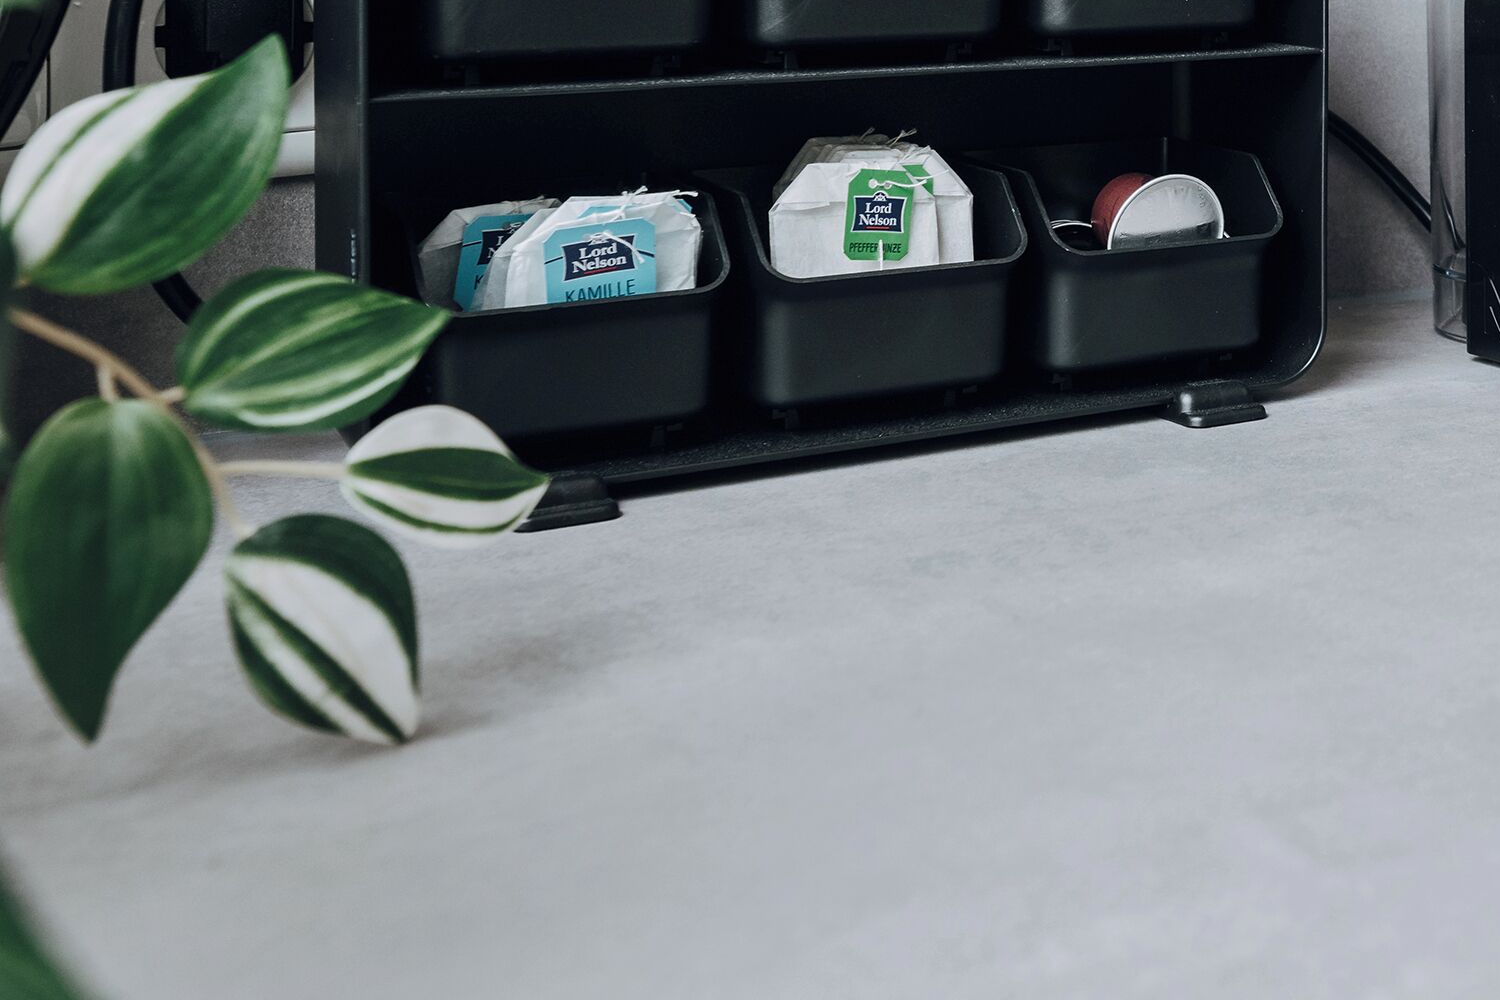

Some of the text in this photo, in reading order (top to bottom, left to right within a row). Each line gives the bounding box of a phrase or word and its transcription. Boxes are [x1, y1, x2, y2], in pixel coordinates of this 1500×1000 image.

[865, 202, 892, 214] Lord
[858, 213, 897, 226] Nelson
[578, 242, 618, 260] Lord
[849, 242, 902, 253] PFEFFERINZE
[571, 256, 627, 274] Nelson
[565, 278, 636, 303] KAMILLE
